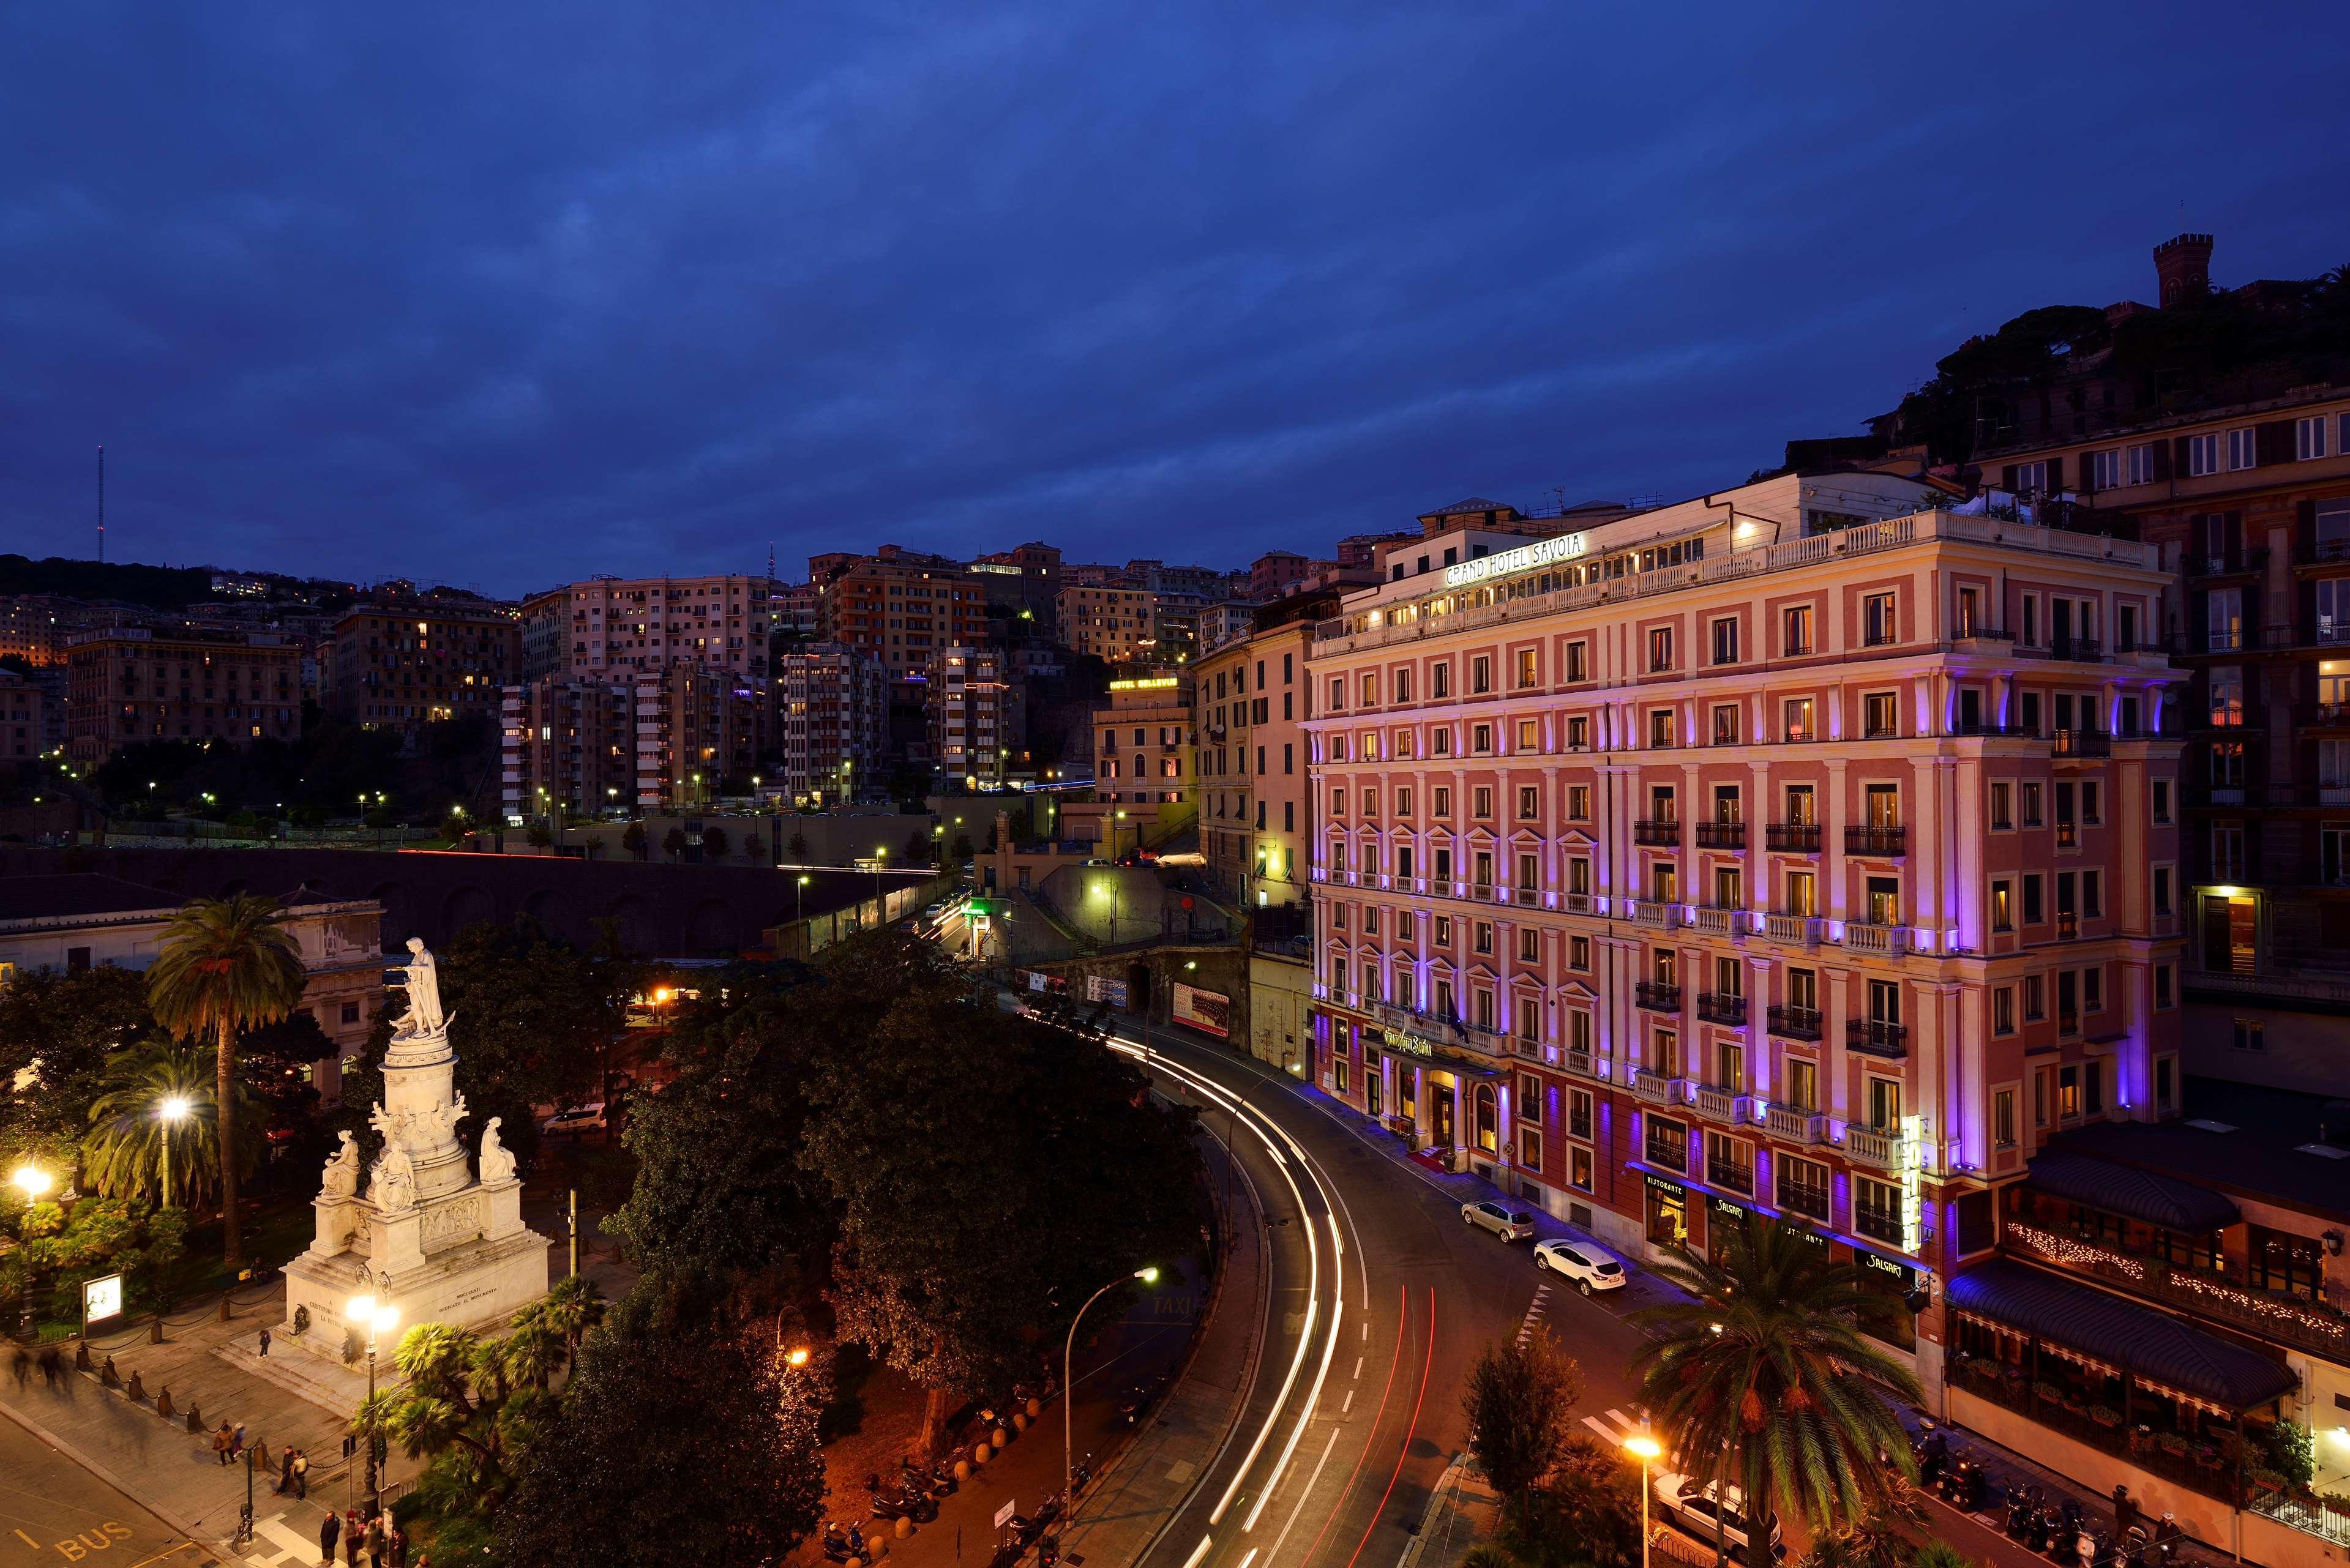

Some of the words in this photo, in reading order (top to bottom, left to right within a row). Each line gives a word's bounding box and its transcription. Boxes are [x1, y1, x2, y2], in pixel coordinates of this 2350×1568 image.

[1446, 559, 1484, 584] GRAND
[1489, 549, 1527, 573] HOTEL
[1533, 534, 1582, 563] SAVOIA
[1110, 681, 1135, 690] HOTEL
[1138, 678, 1178, 688] BELLEVUE
[1647, 1176, 1682, 1195] RISTORANTE
[1909, 1114, 1922, 1252] HOTEL
[1715, 1198, 1743, 1219] SALGARI
[1781, 1225, 1823, 1246] STANTE
[1866, 1254, 1901, 1279] SALGARI
[439, 1301, 461, 1313] DEDICATO
[471, 1288, 498, 1301] MONUMENTO
[1153, 1297, 1191, 1314] TAXI
[54, 1521, 134, 1562] BUS
